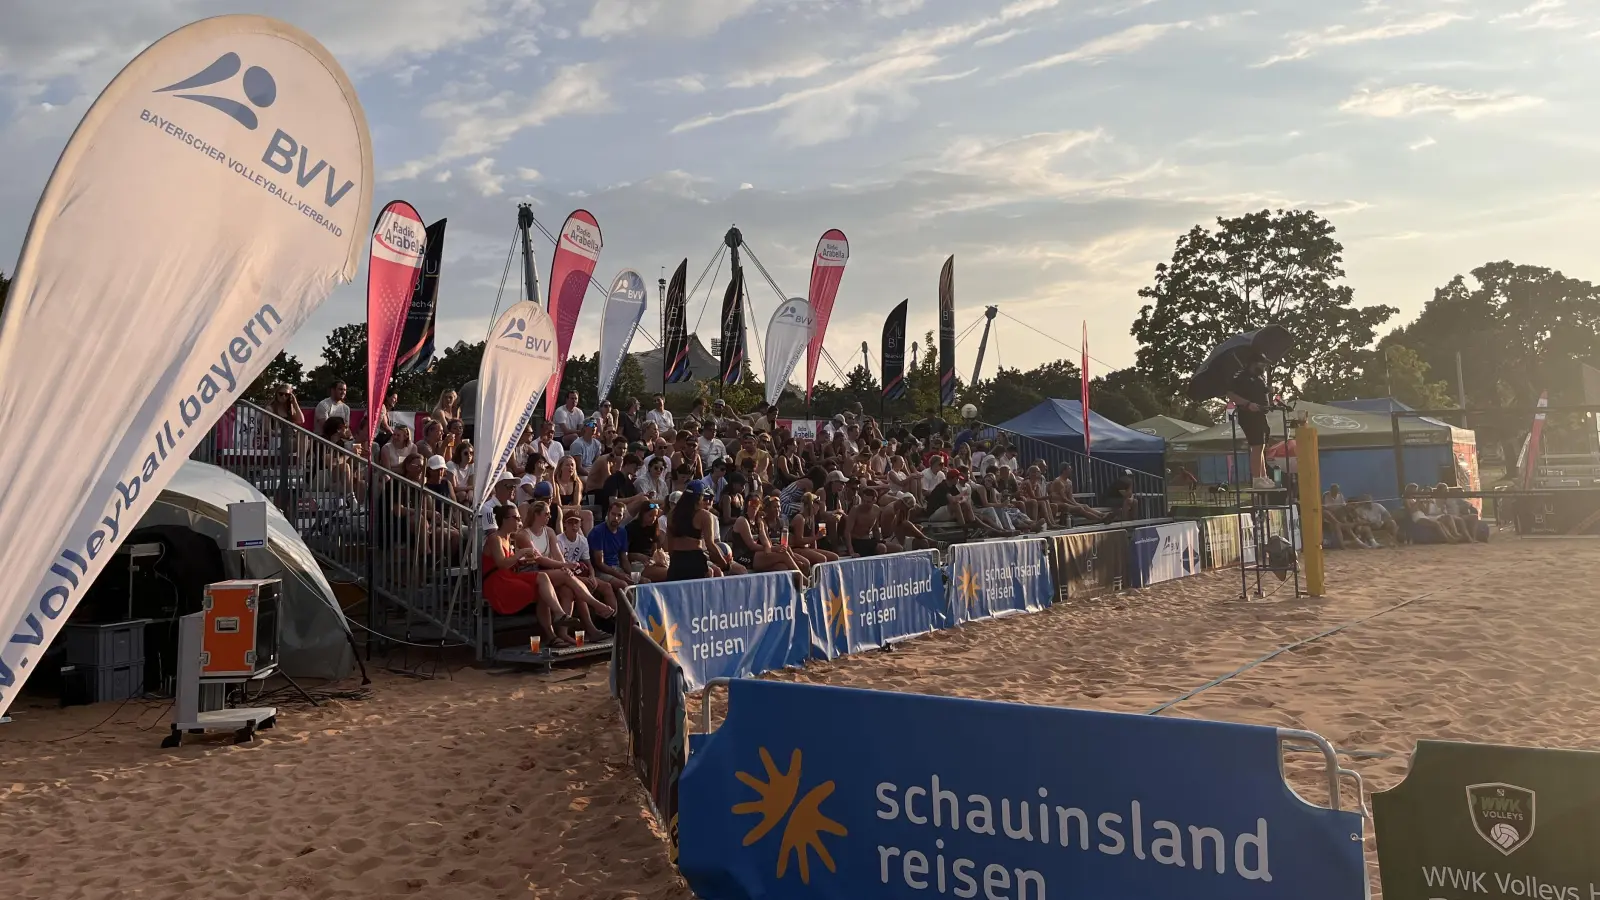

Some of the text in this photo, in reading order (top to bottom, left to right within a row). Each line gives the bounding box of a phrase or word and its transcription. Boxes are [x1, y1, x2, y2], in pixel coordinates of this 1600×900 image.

[139, 108, 343, 238] BAYERISCHER VOLLEYBALL-VERBAND
[261, 128, 354, 208] BVV
[393, 221, 415, 239] Radio
[571, 230, 600, 251] Arabella
[576, 225, 591, 238] Radio
[384, 228, 424, 255] Arabela
[627, 289, 644, 300] BVV
[795, 316, 813, 325] BVV
[525, 336, 552, 353] BVV
[984, 560, 1042, 582] schauinsland
[859, 574, 932, 605] schauinsland
[985, 583, 1015, 601] reisen
[691, 603, 793, 634] schauinsland
[859, 606, 897, 628] reisen
[691, 635, 745, 661] reisen
[1481, 796, 1522, 812] WWK
[1482, 810, 1524, 821] VOLLEYS
[876, 774, 1273, 882] schauinsland
[877, 838, 1047, 900] reisen
[1421, 865, 1489, 894] WWK
[1494, 872, 1580, 900] Volleys
